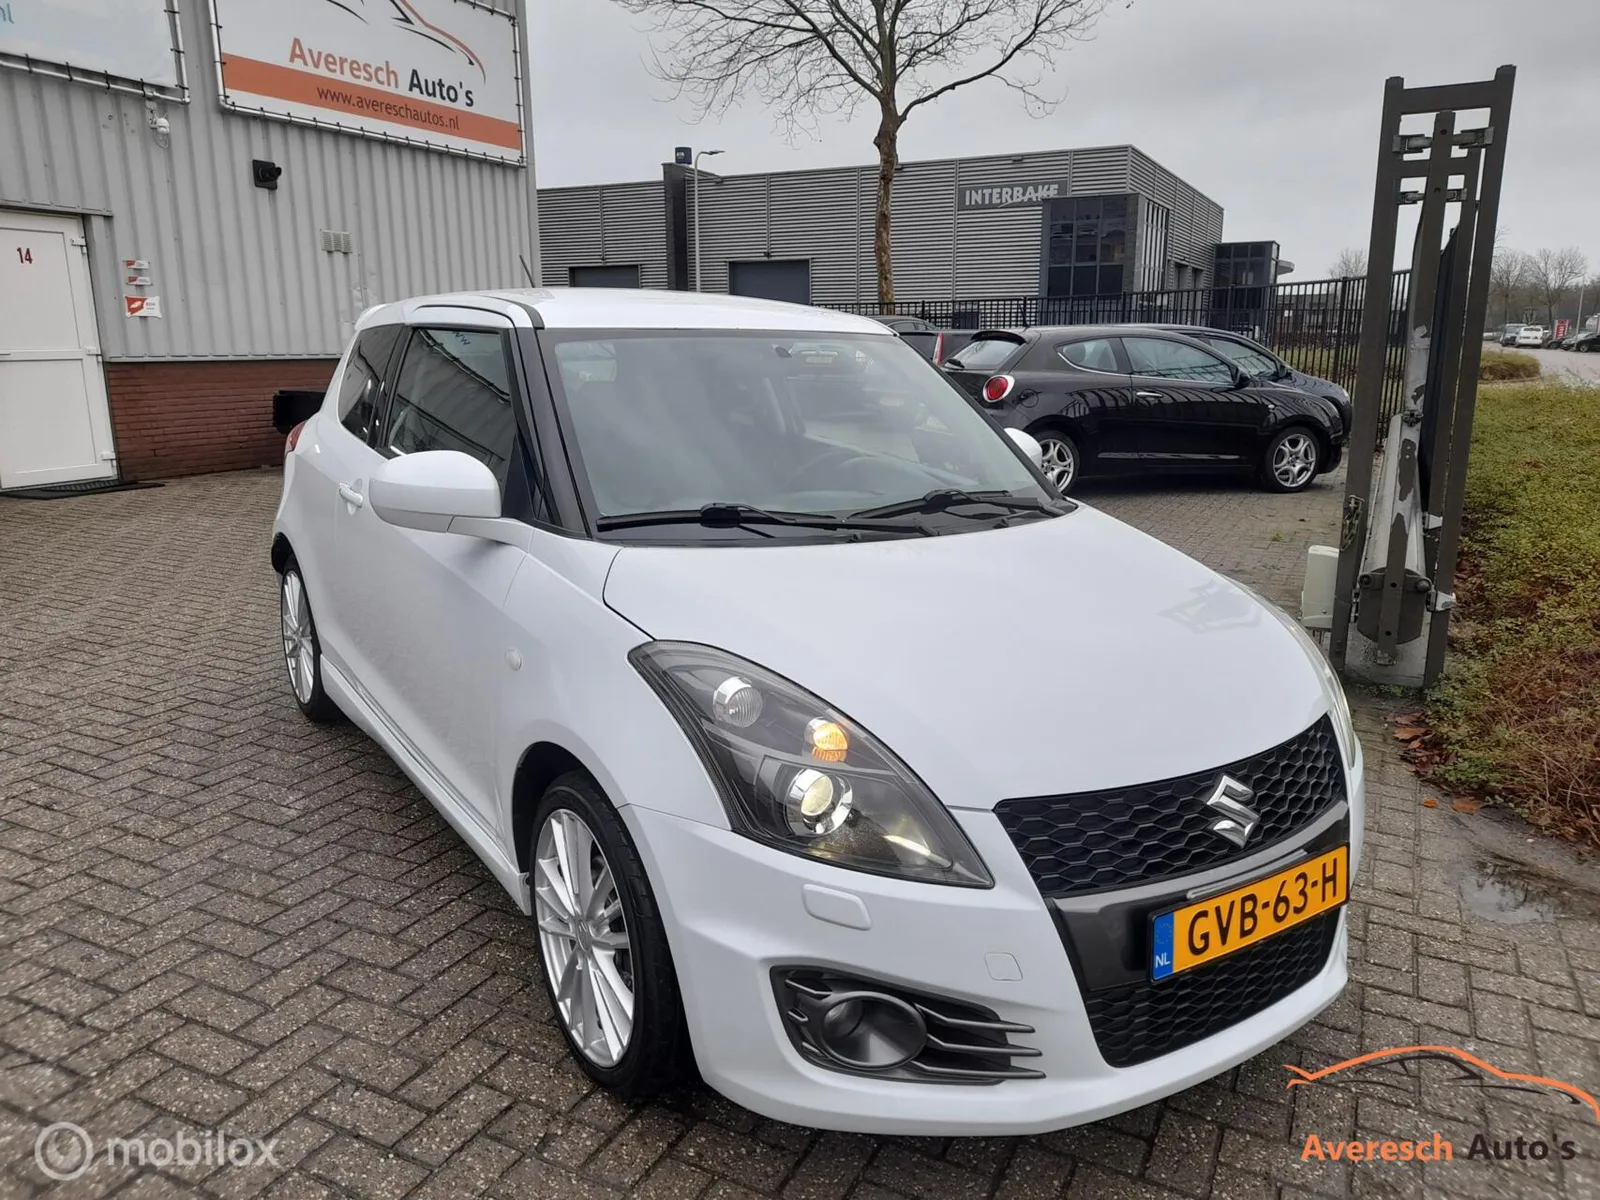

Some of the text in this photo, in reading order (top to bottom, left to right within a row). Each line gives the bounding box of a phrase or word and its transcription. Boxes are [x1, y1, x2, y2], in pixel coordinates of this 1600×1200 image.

[288, 37, 475, 107] Averesch Auto's
[316, 86, 460, 131] www.avereschautos.nl
[965, 184, 1059, 206] INTERBAKE
[16, 247, 34, 264] 14
[1187, 857, 1338, 956] GVB-63-H
[1155, 952, 1171, 969] NL
